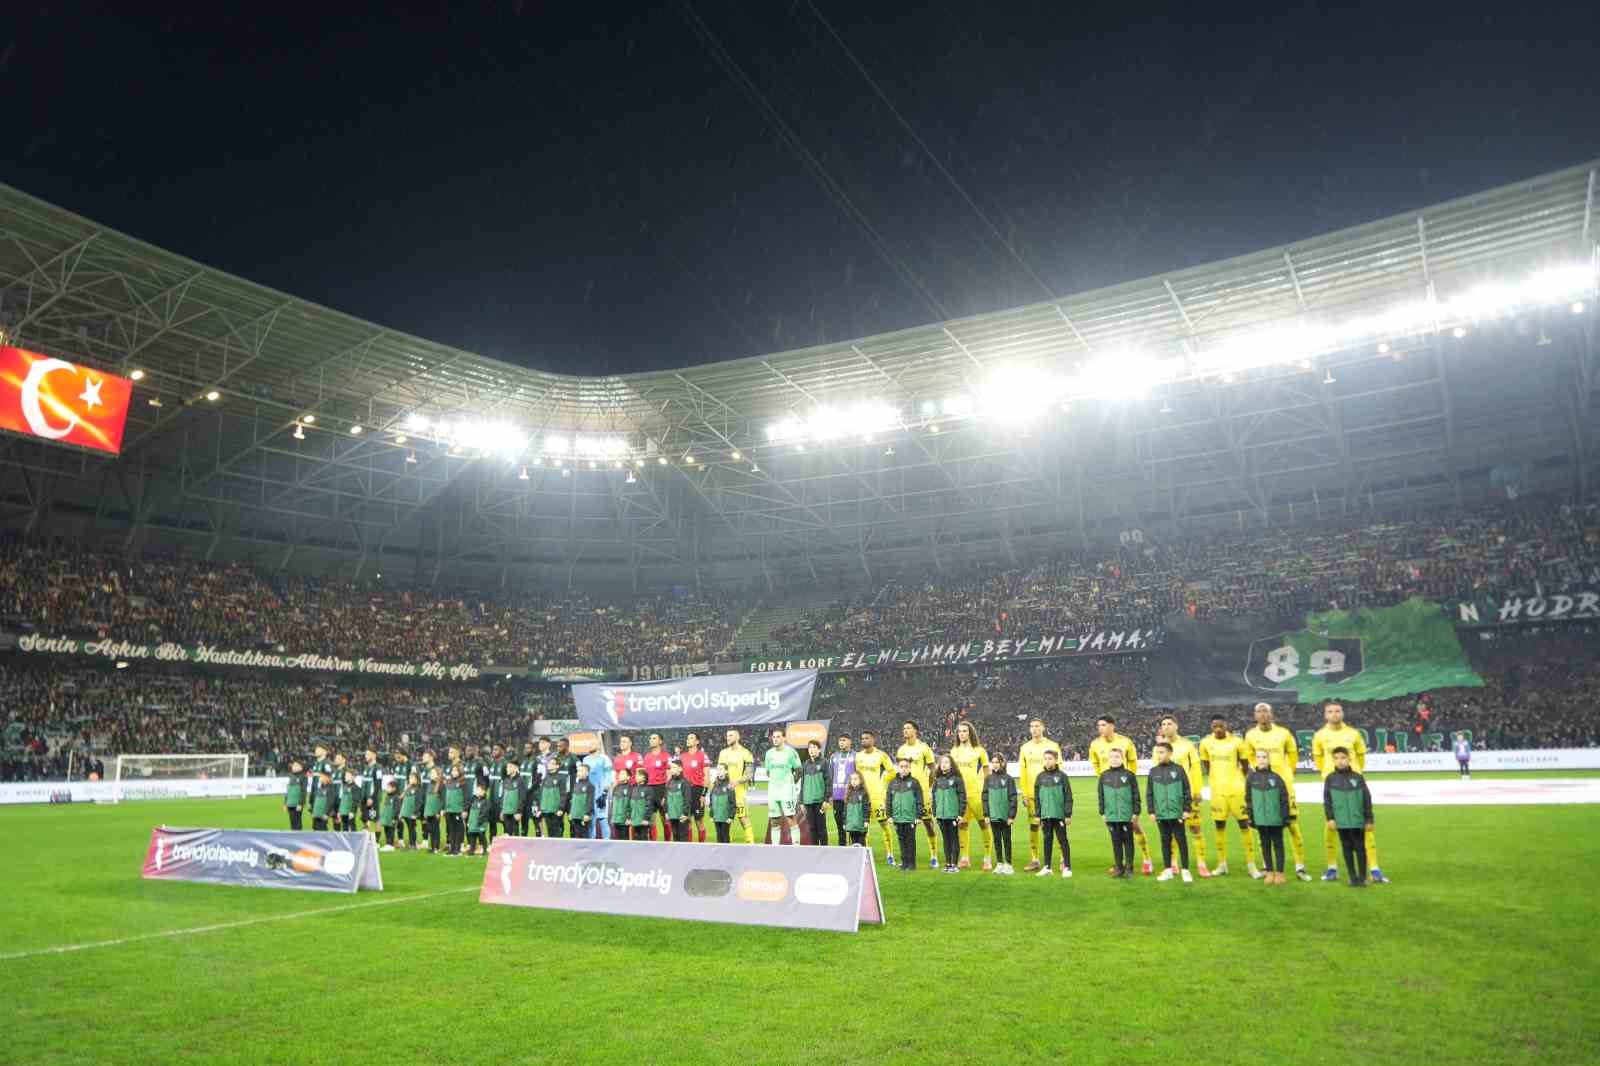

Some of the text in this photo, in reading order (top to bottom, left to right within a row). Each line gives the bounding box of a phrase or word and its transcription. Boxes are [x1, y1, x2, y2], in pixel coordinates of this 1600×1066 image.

[19, 634, 77, 652] Senin
[84, 639, 149, 660] Aşkın
[154, 643, 187, 661] Bir
[357, 657, 415, 675] Vermesin
[750, 660, 792, 672] FORZA
[1263, 645, 1346, 682] 89
[629, 688, 708, 714] trendyol
[528, 860, 604, 888] trendyol
